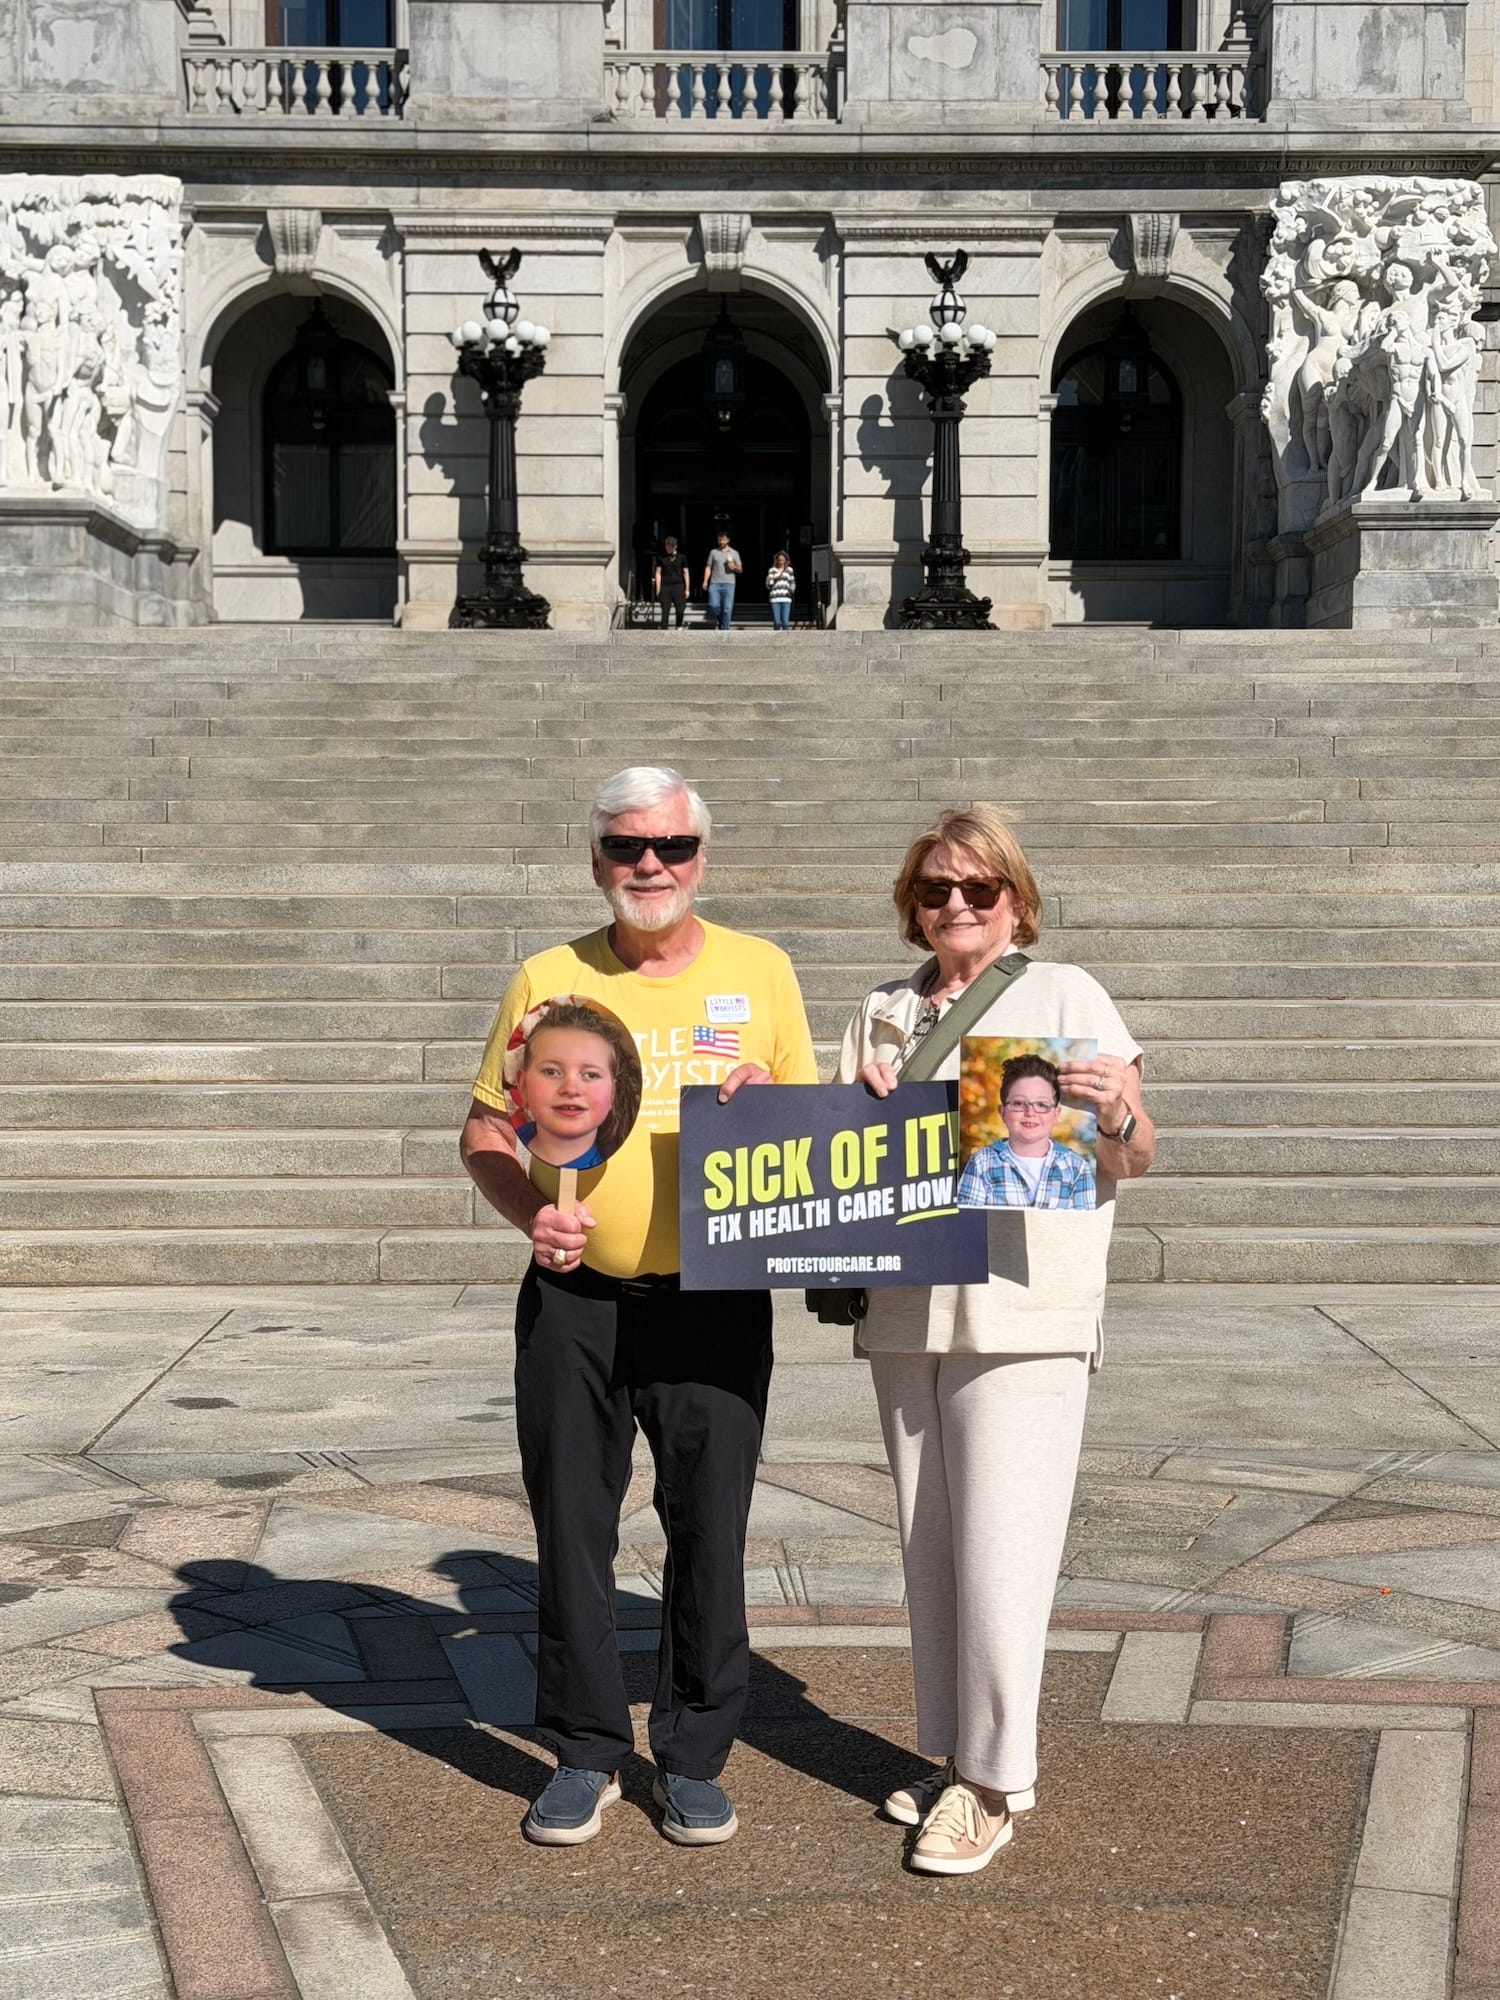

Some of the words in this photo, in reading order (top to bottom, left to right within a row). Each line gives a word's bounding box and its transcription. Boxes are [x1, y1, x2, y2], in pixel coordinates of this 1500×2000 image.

[703, 1136, 815, 1211] SICK
[830, 1123, 888, 1190] OF
[905, 1111, 958, 1178] IT!
[708, 1212, 742, 1245] FIX
[749, 1198, 830, 1239] HEALTH
[837, 1186, 895, 1223] CARE
[901, 1176, 957, 1213] NOW.
[766, 1255, 902, 1274] PROTECTOURCARE.ORG
